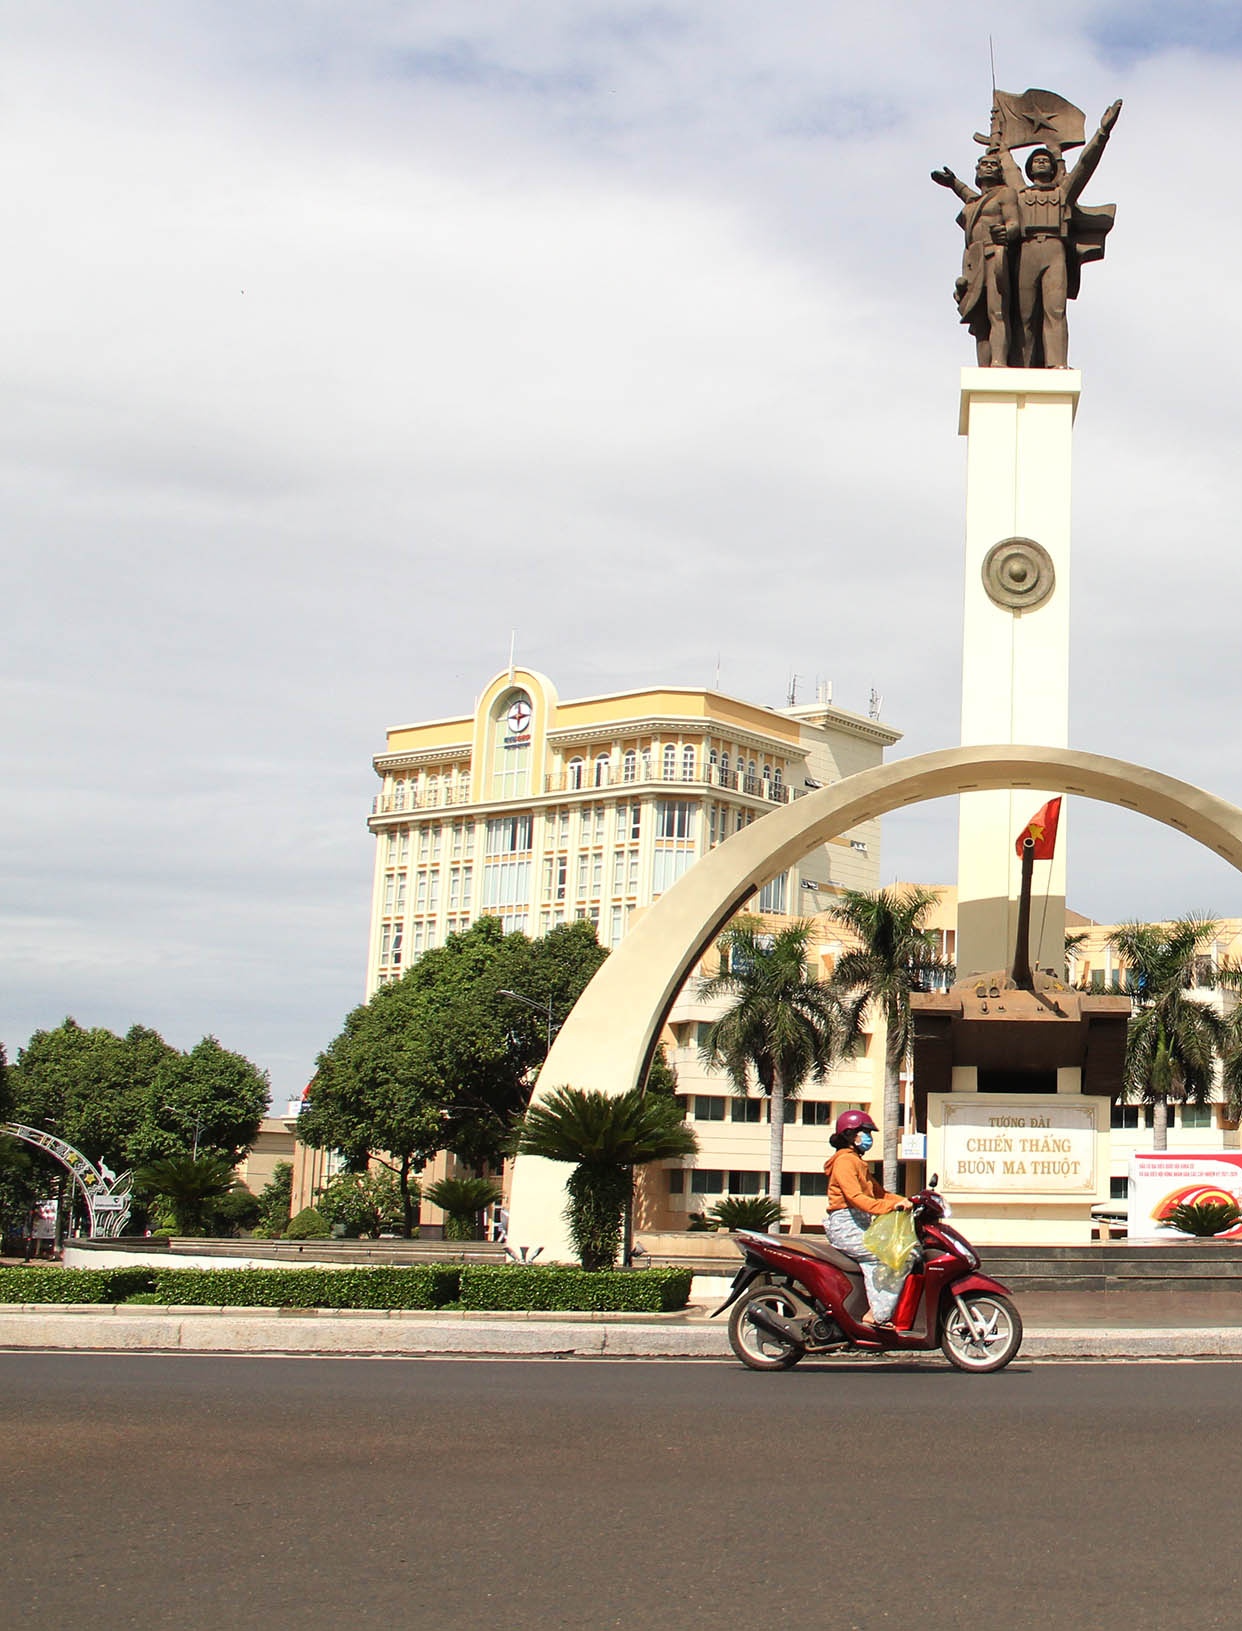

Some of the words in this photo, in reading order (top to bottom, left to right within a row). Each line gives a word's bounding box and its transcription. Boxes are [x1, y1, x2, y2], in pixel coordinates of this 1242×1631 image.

[1030, 1115, 1051, 1128] ĐÀI
[966, 1133, 1013, 1152] CHIẾN
[1019, 1133, 1071, 1152] THẮNG
[957, 1156, 995, 1174] BUÔN
[1002, 1160, 1027, 1174] MA
[1031, 1157, 1080, 1178] THUỘT
